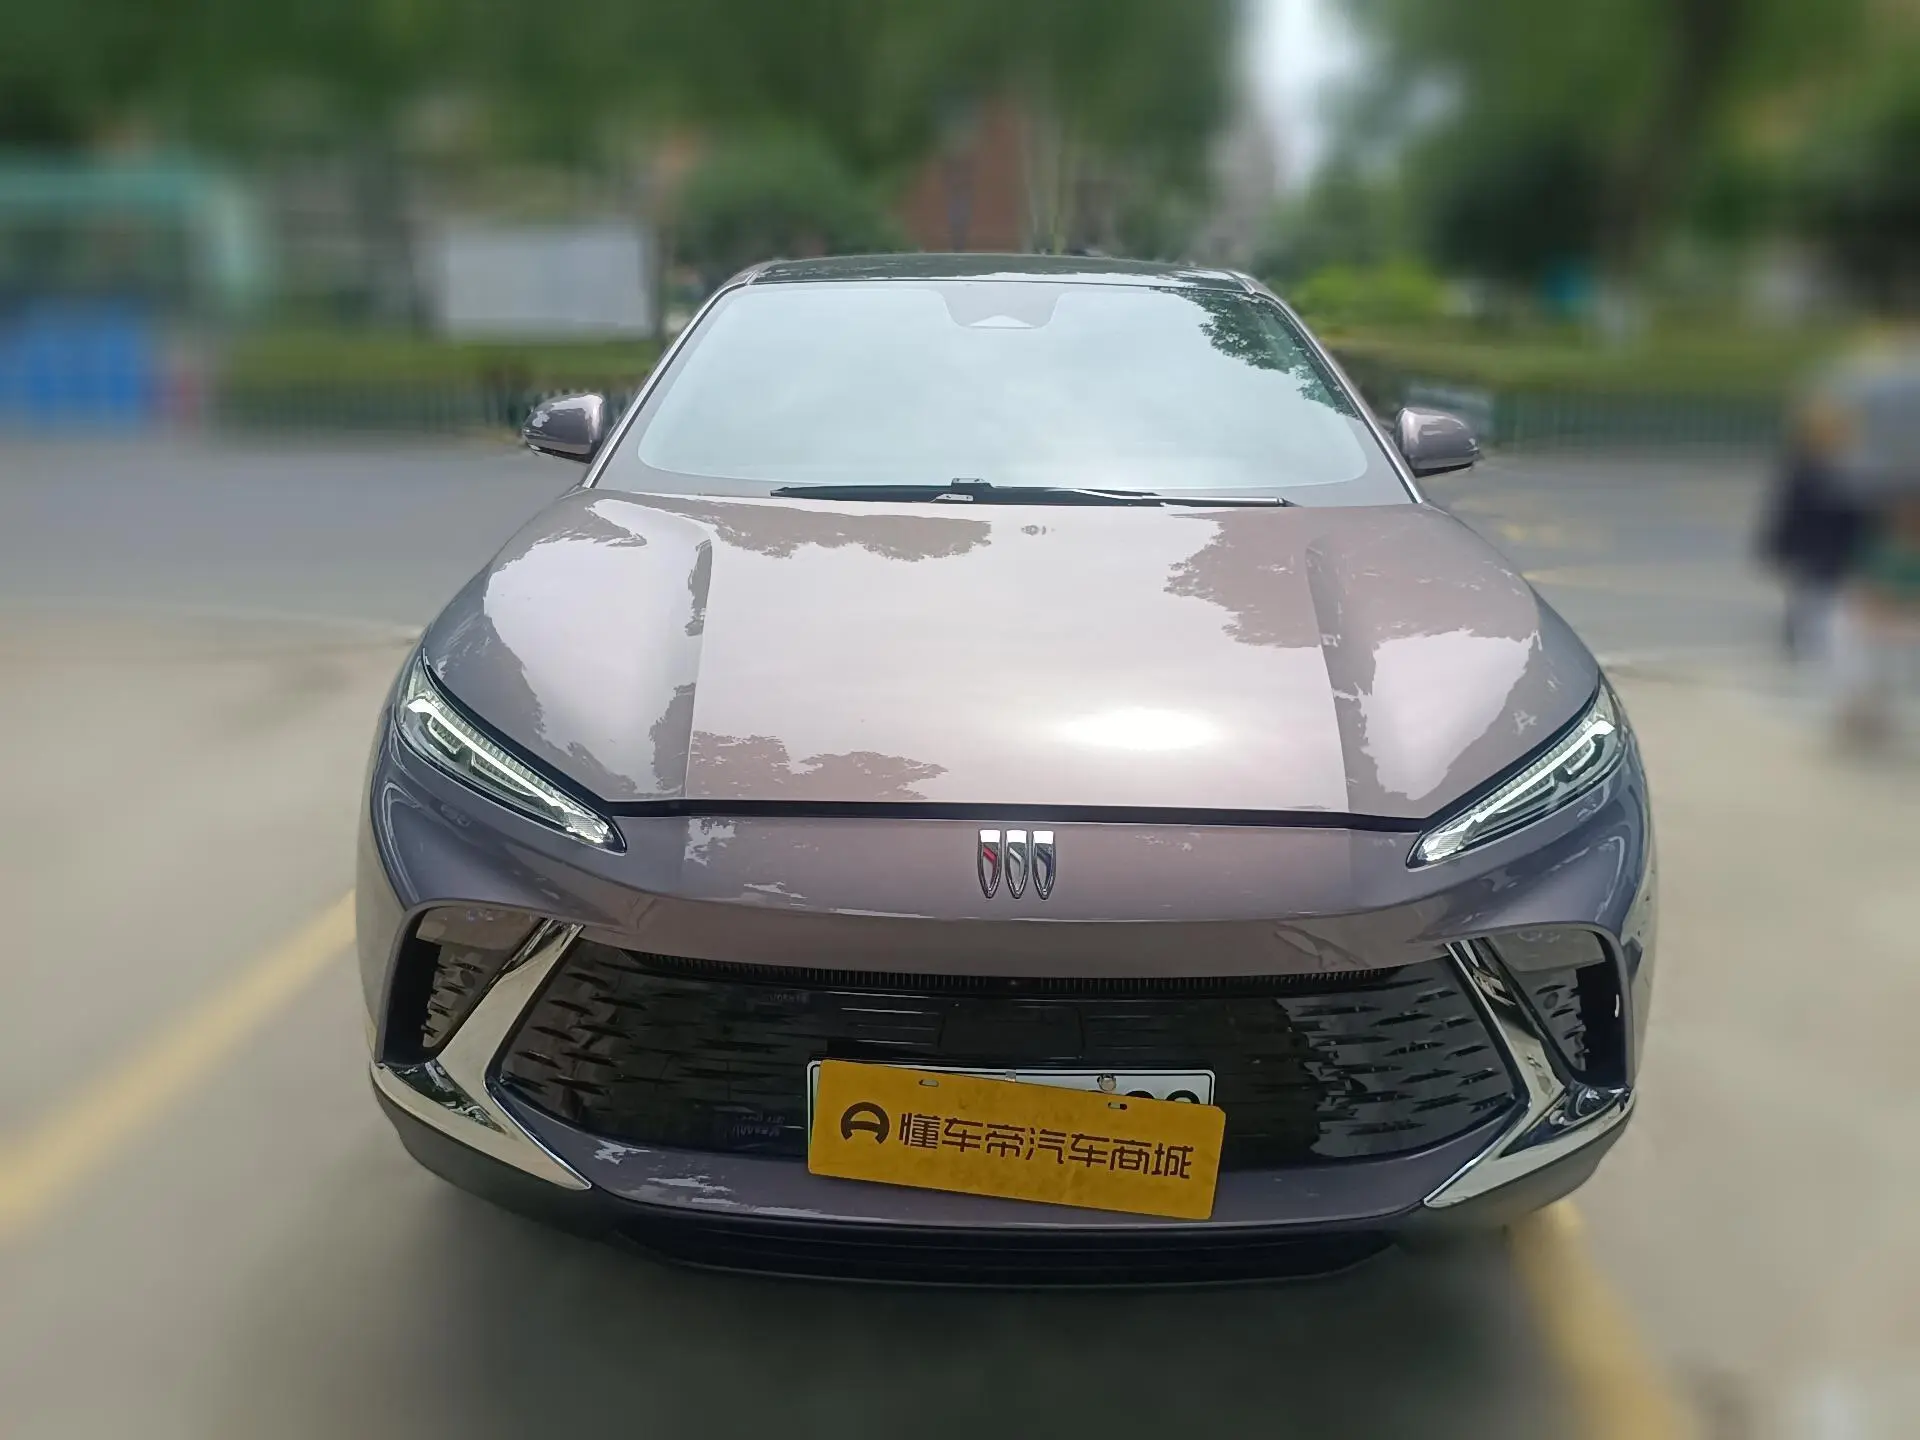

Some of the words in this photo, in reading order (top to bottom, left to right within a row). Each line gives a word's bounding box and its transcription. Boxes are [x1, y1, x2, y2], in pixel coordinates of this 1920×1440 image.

[899, 1112, 1194, 1179] 懂车帝汽车商城
